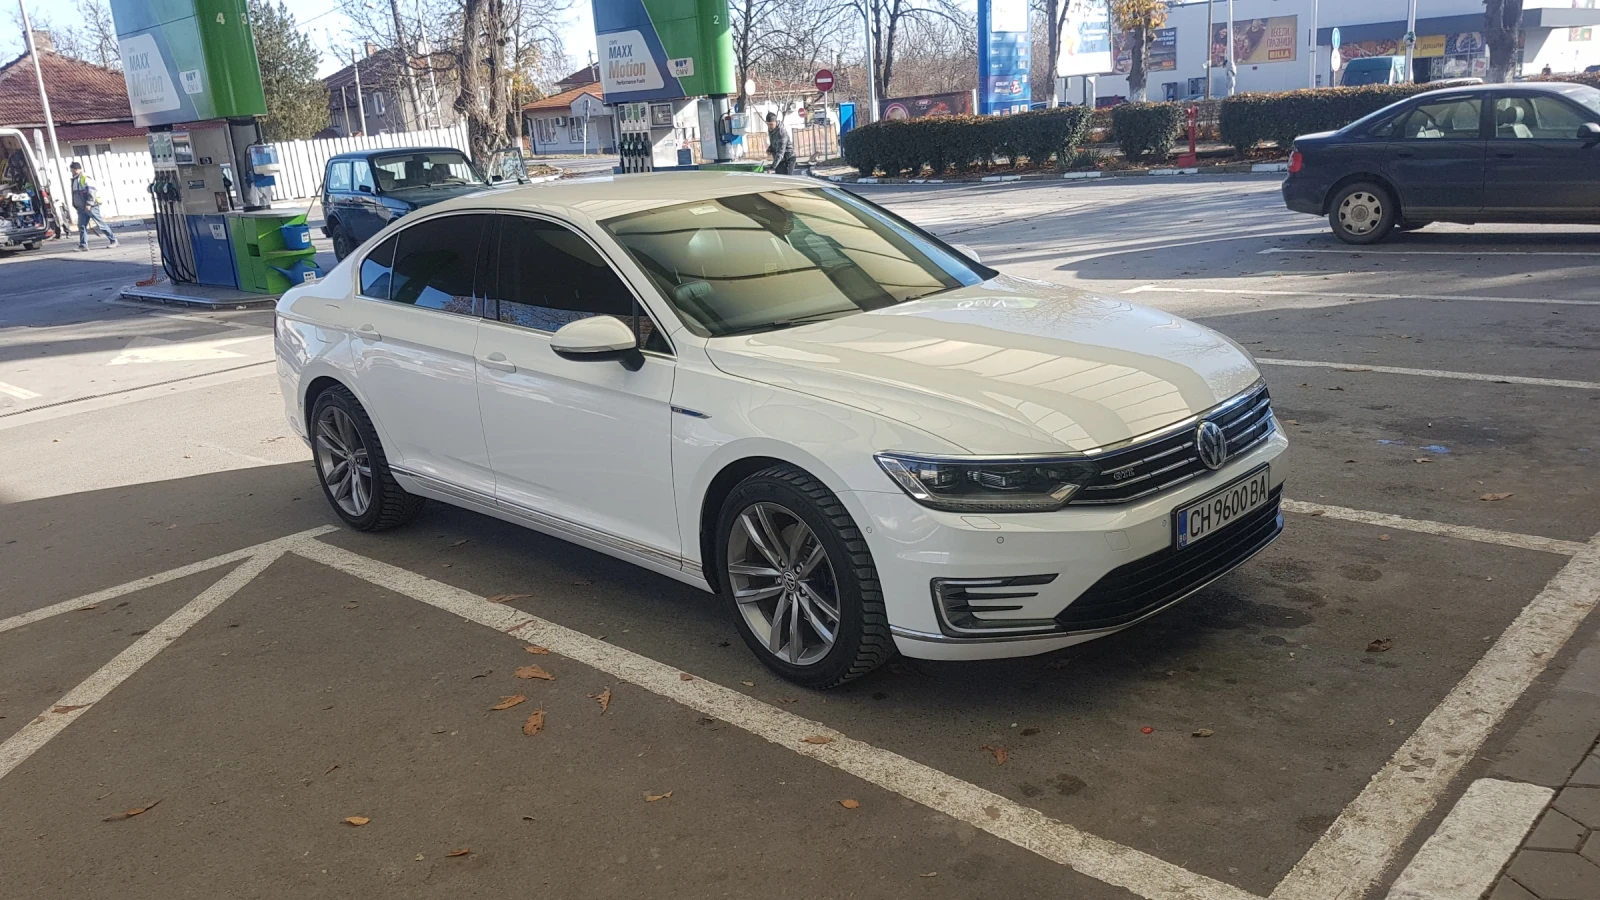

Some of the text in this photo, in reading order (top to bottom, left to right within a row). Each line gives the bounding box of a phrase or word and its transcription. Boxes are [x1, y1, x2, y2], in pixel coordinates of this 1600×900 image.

[216, 12, 225, 25] 4
[241, 12, 248, 25] 3
[713, 14, 720, 25] 2
[1270, 27, 1290, 37] ВЕСЕЛИ
[1267, 37, 1293, 48] ПРАЗНИЦИ
[609, 45, 633, 59] MAXX
[1269, 50, 1290, 59] BILLA
[129, 52, 150, 71] MAXX
[609, 58, 646, 79] Motion
[675, 67, 689, 75] OMV
[131, 71, 164, 97] Motion
[1214, 485, 1248, 527] 9600
[1250, 475, 1266, 506] BA
